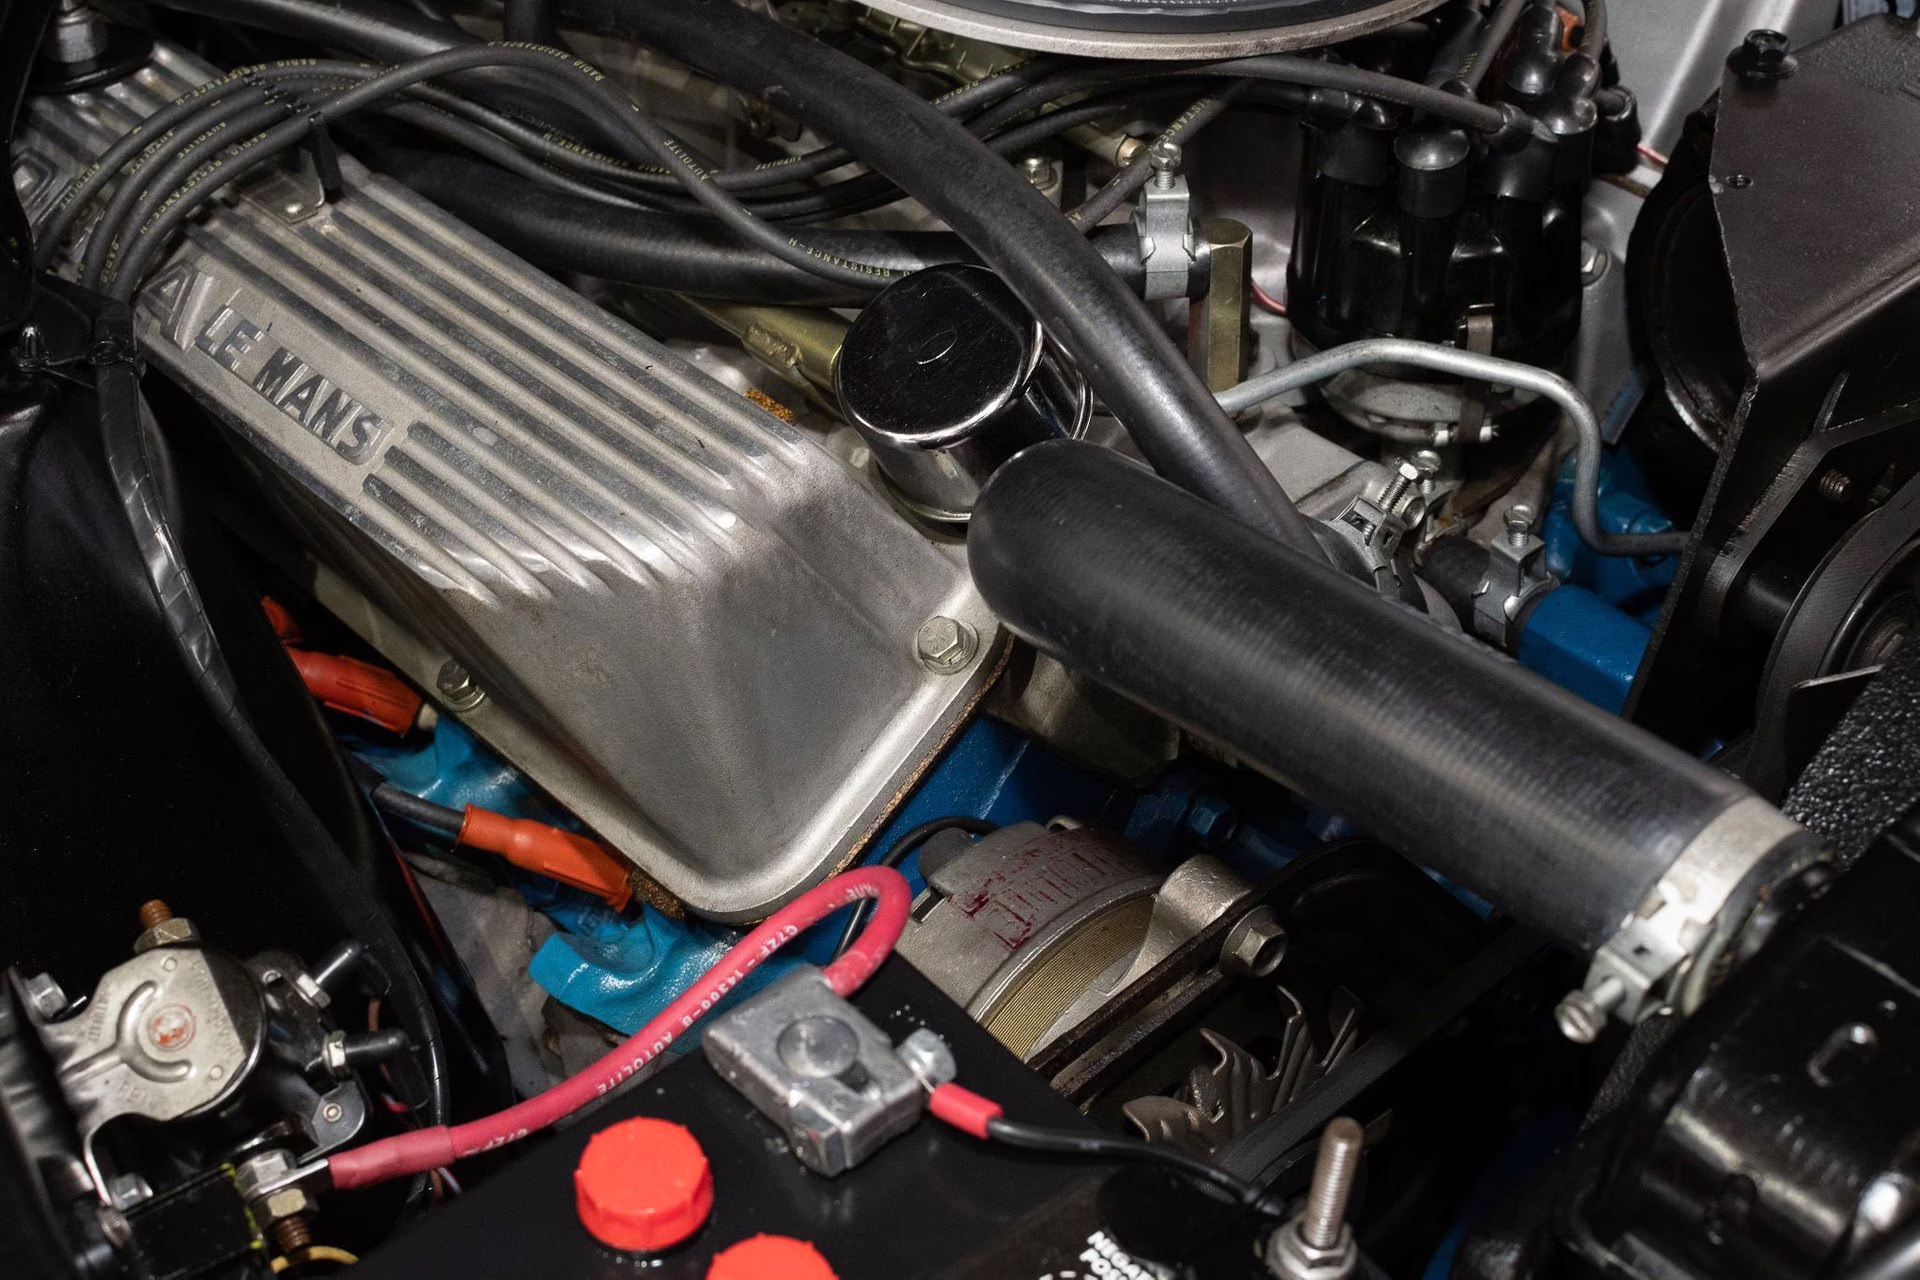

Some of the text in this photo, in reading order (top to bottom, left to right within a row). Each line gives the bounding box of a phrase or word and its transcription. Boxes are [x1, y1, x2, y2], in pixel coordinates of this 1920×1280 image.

[129, 130, 176, 176] AUTOLITE
[178, 121, 227, 160] AUTOLITE
[663, 138, 710, 182] AUTOLITE
[788, 237, 890, 278] RESISTANCE-H
[193, 302, 269, 373] LE
[252, 345, 390, 463] MANS
[595, 1031, 674, 1096] AUTOLITE
